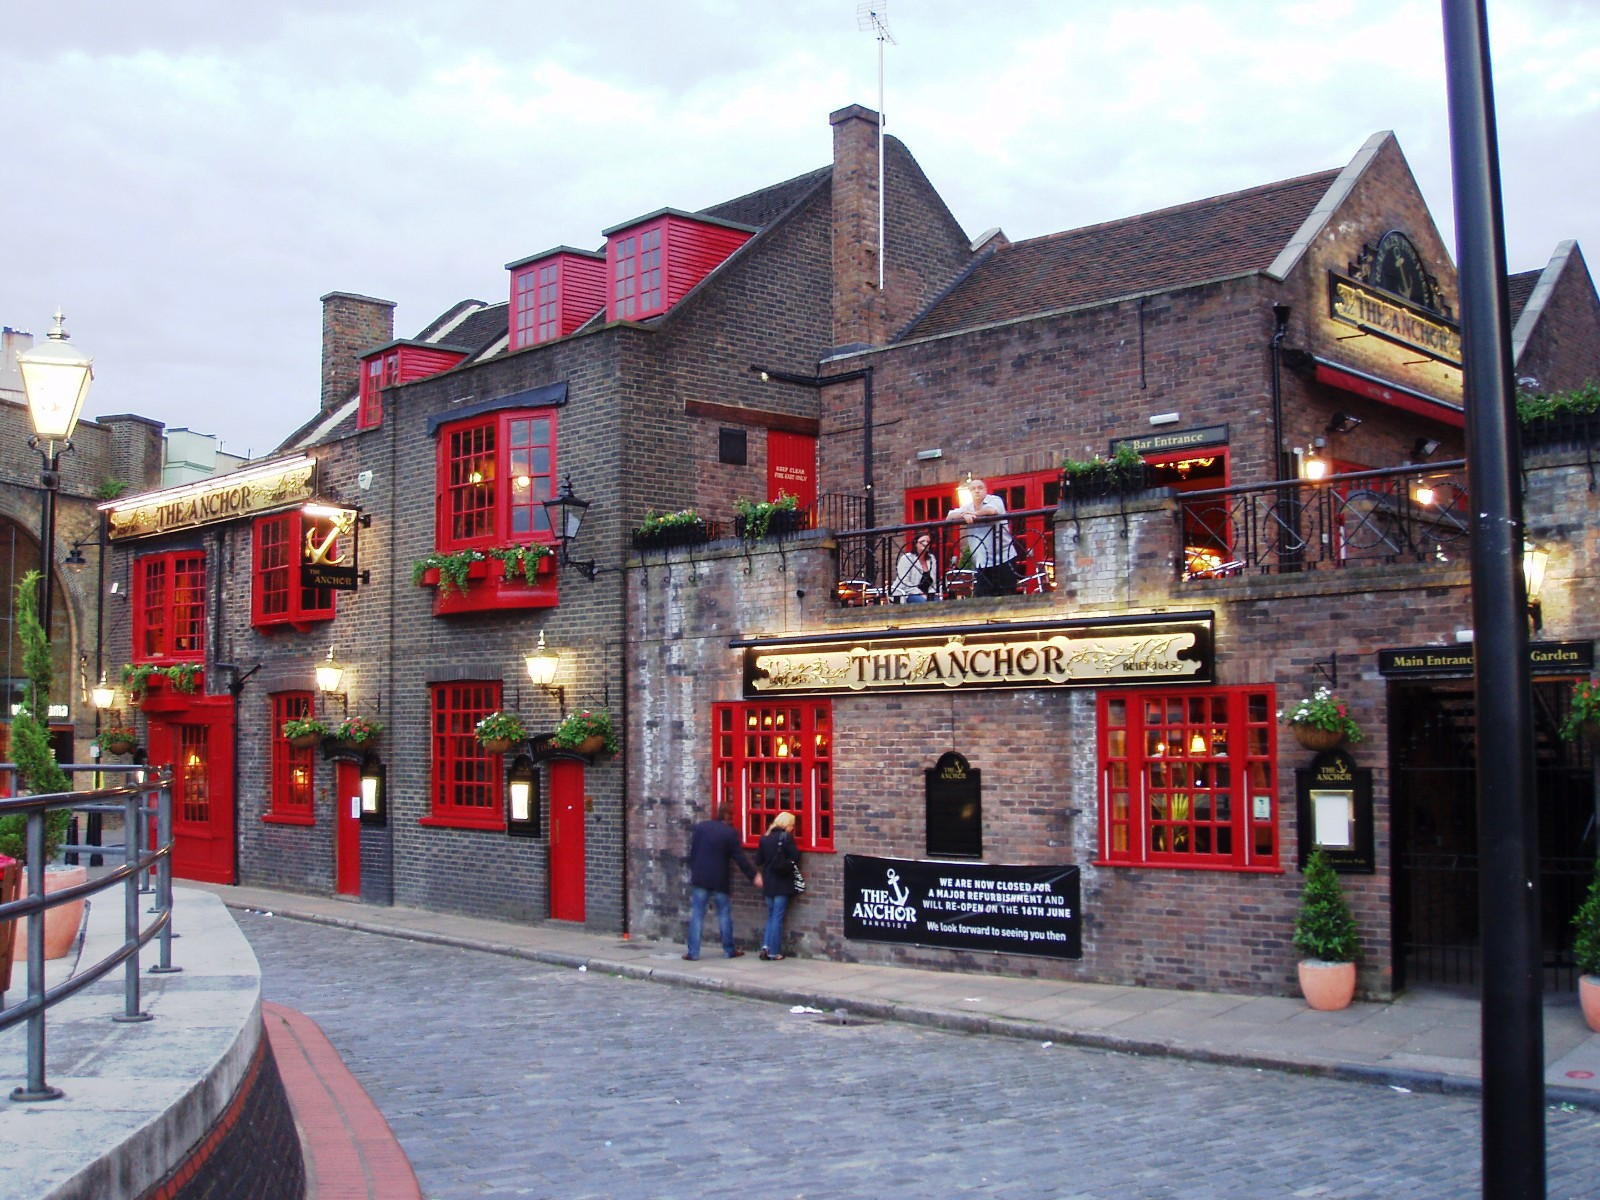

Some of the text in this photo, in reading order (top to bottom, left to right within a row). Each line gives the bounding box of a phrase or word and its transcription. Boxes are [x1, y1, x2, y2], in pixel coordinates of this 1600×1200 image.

[1360, 299, 1450, 352] THE ANCHOR
[1133, 433, 1203, 450] Bar Entrance
[157, 502, 185, 526] THE
[187, 485, 251, 519] ANCHOR
[315, 576, 352, 586] ANCHOR
[852, 644, 1066, 682] THE ANCHOR
[1394, 650, 1578, 667] Main Entranc Garden
[1316, 773, 1352, 781] ANCHOR
[939, 878, 1051, 892] WE ARE NOW CLOSED FOR
[860, 888, 889, 904] THE
[928, 889, 1063, 905] A MAJOR REFURBISHMENT AND
[852, 903, 917, 923] ANCHOR
[923, 900, 1071, 918] WILL RE-OPEN ON THE 16TH JUNE
[862, 920, 907, 930] BANKSIDE
[927, 921, 1066, 941] We look forward to seeing you then
